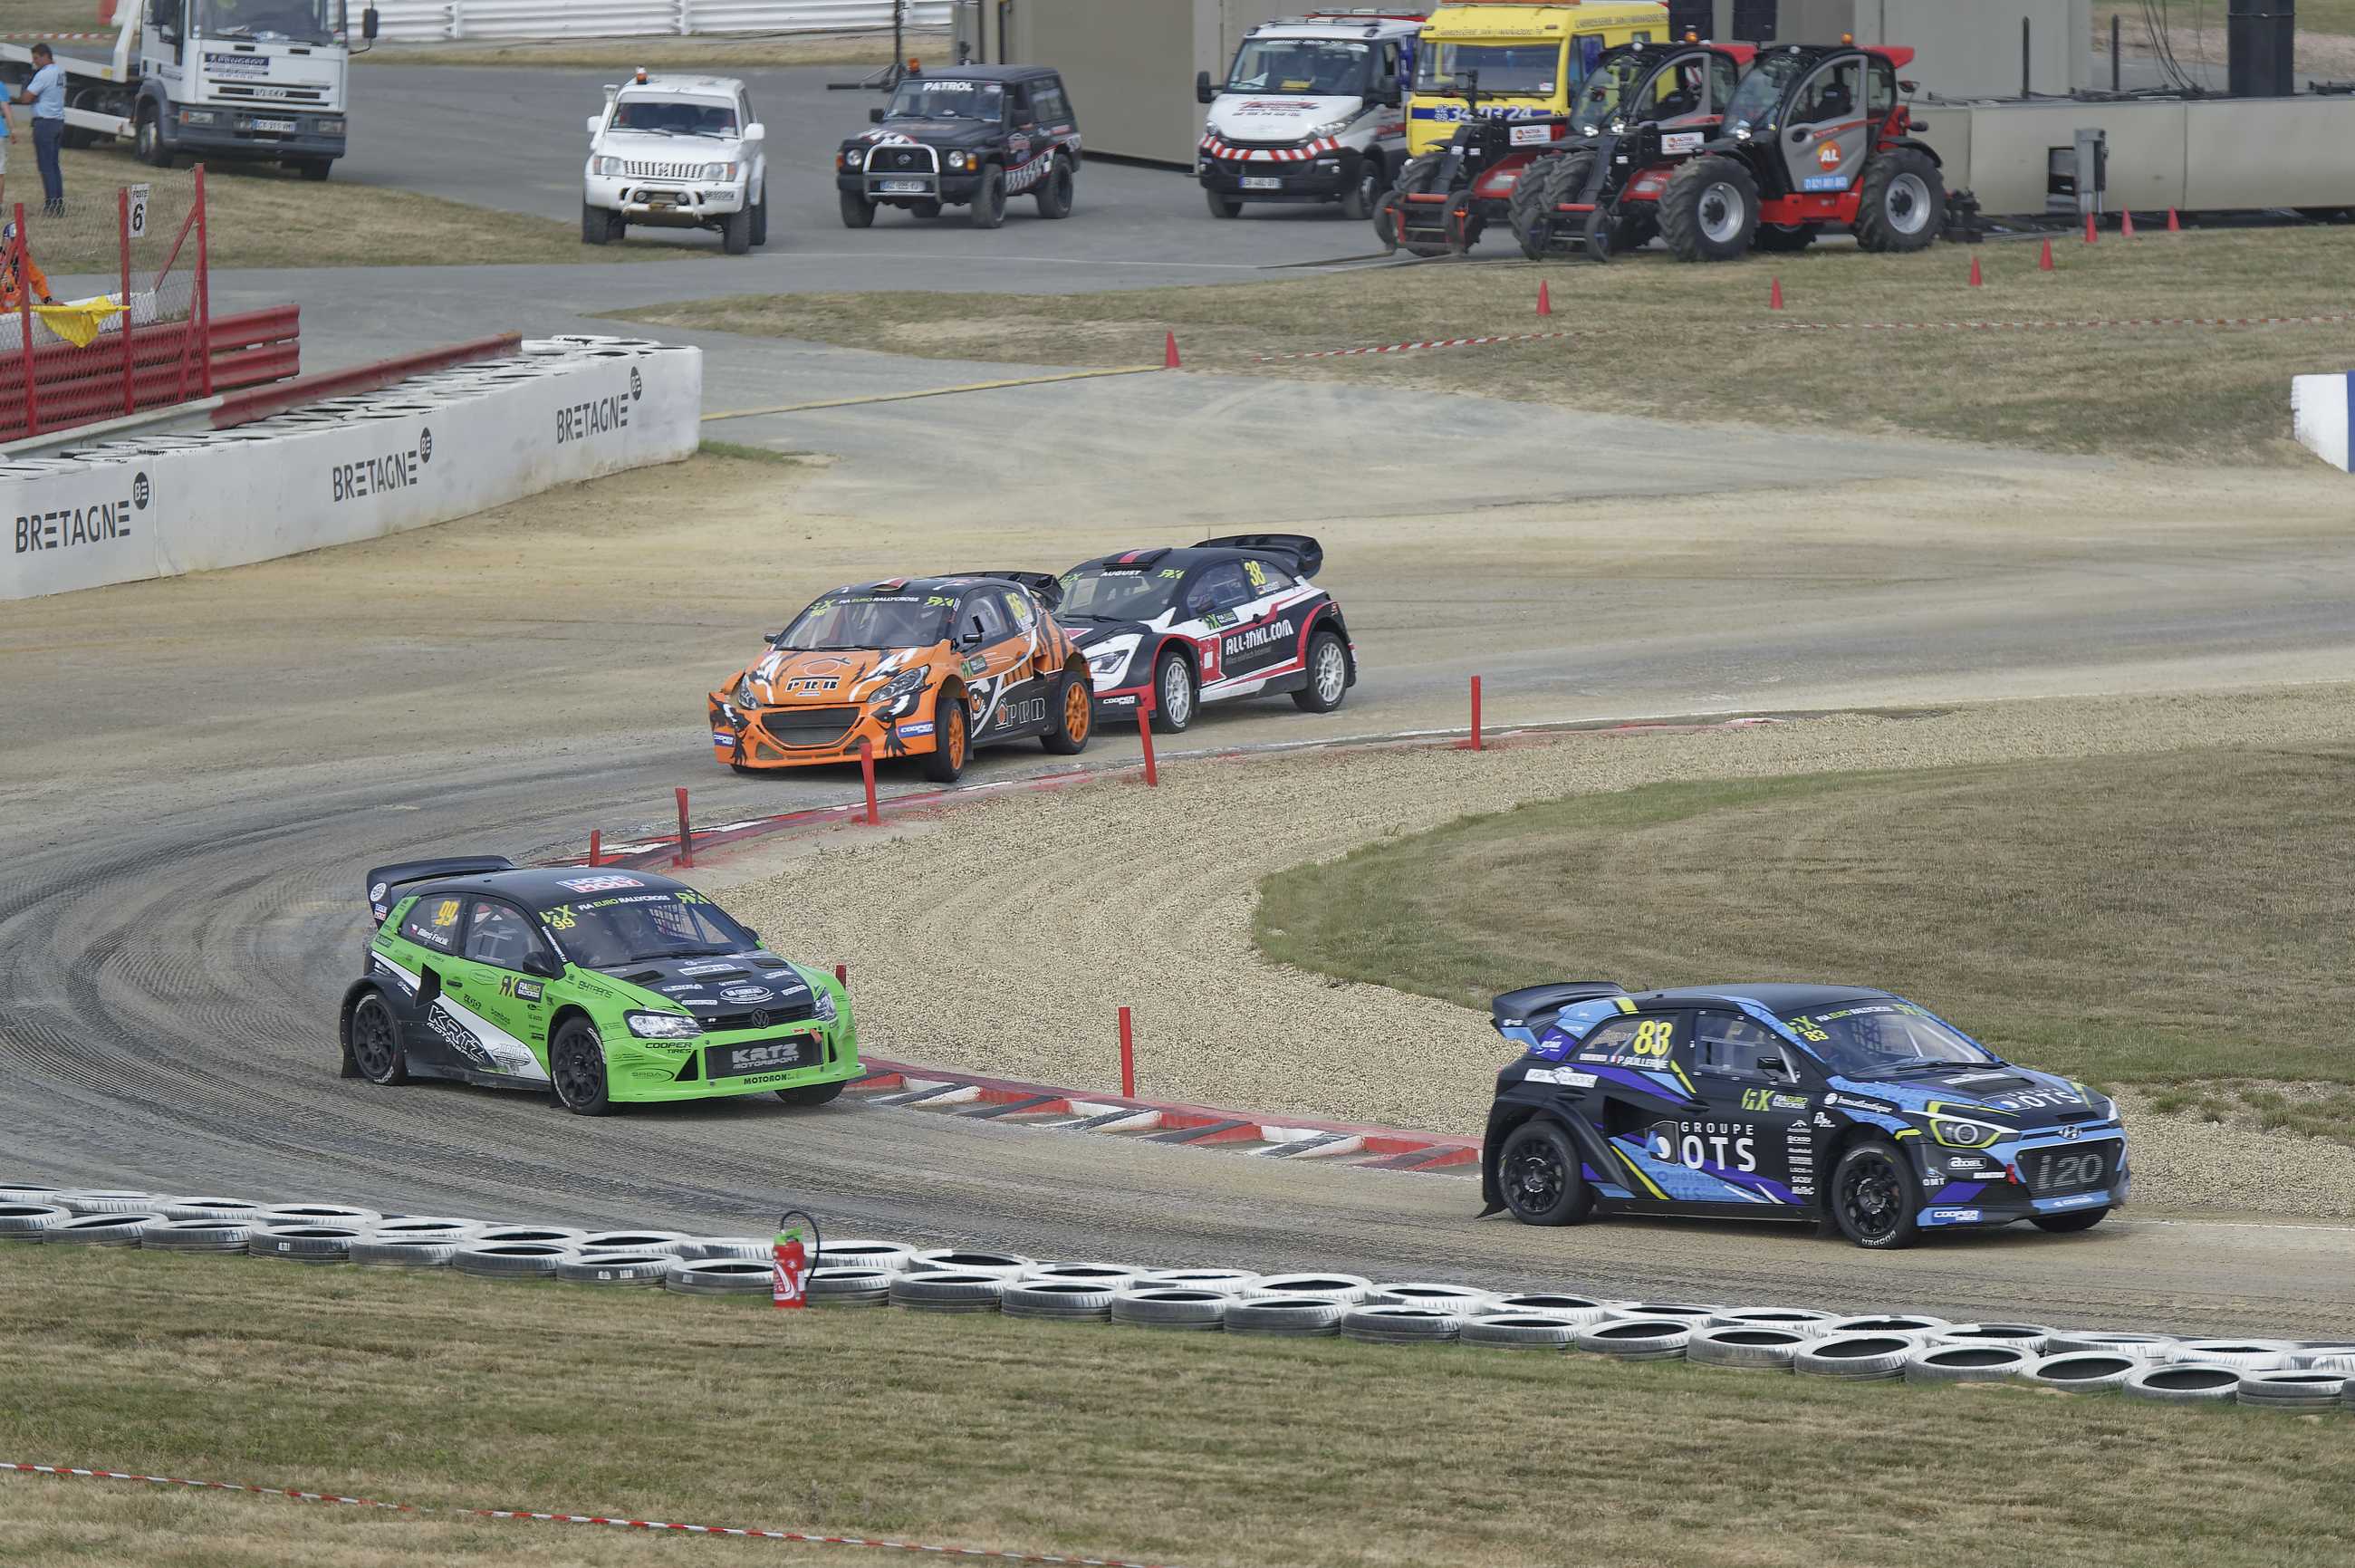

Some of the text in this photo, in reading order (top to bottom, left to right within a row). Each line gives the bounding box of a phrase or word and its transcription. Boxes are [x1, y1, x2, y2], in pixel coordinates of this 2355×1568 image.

[922, 82, 974, 91] PATROL
[1820, 149, 1840, 162] AL
[132, 203, 144, 231] 6
[556, 392, 629, 445] BRETAGNE
[332, 449, 418, 503] BRETAGNE
[14, 500, 130, 553] BRETAGNE
[1244, 560, 1266, 586] 38
[1103, 696, 1136, 704] COOPER
[578, 895, 671, 911] FIA EURO RALLYCROSS
[435, 900, 459, 927] 99
[551, 918, 577, 930] 99
[1633, 1020, 1674, 1056] 83
[1803, 1029, 1830, 1042] 83
[733, 1055, 801, 1070] MOTORSPORT
[2016, 1092, 2083, 1109] OTS
[1680, 1121, 1754, 1135] GROUPE
[1681, 1134, 1757, 1173] OTS
